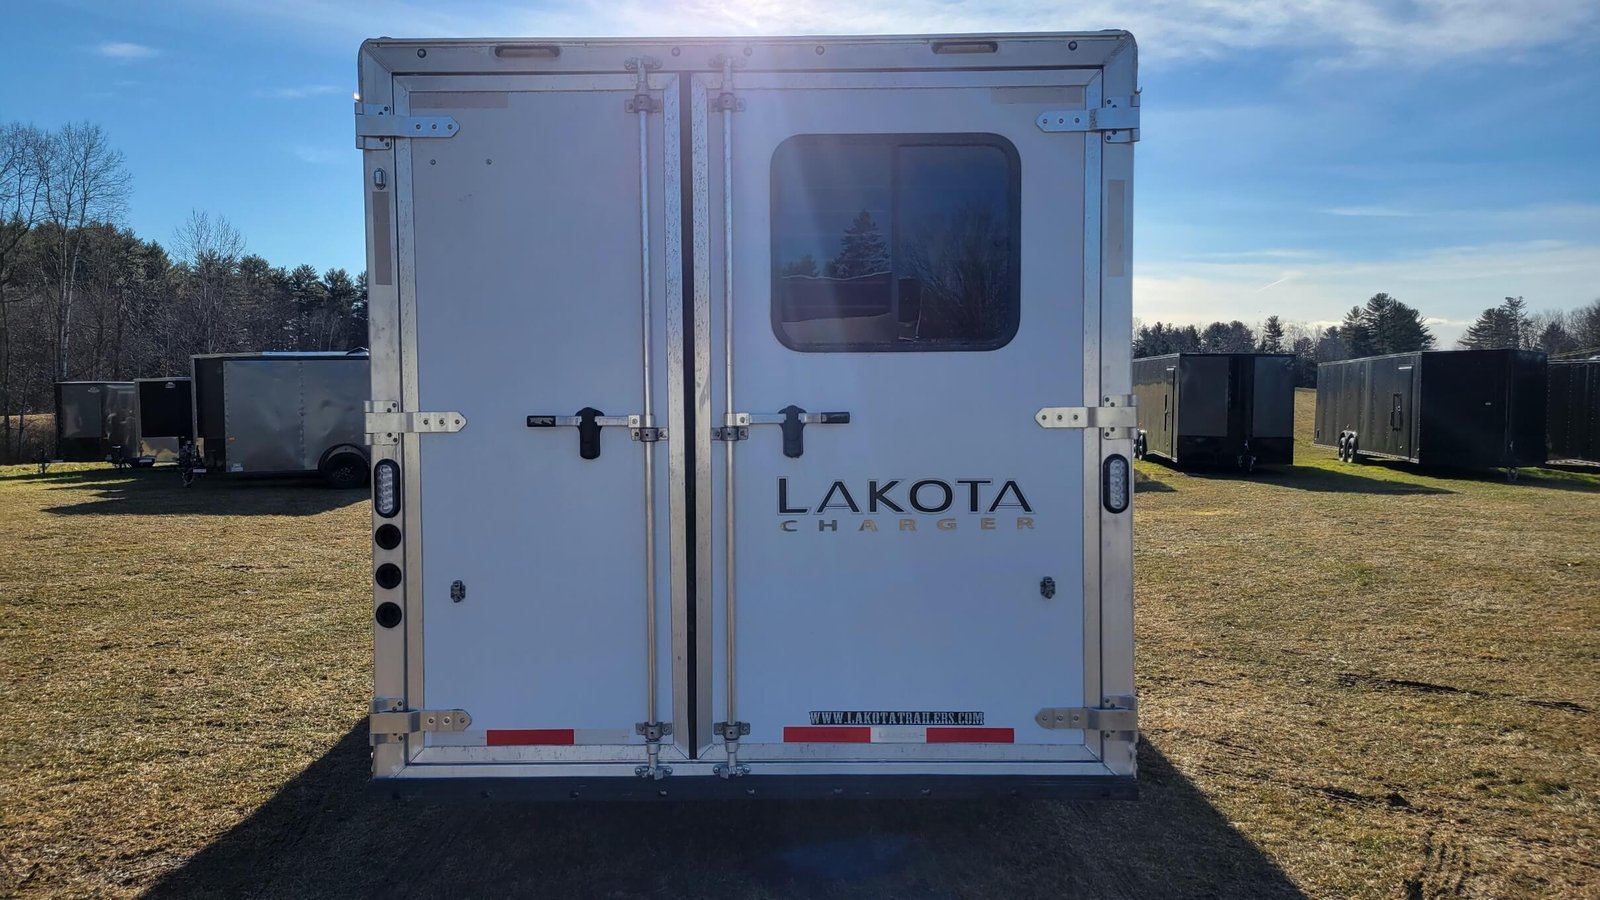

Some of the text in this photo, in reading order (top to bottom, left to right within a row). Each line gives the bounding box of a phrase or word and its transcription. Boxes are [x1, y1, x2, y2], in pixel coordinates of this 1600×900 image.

[777, 476, 1036, 515] LAKOTA
[780, 517, 1035, 532] CHARGER
[809, 711, 985, 725] WWW.LAKOTATRAILERS.COM
